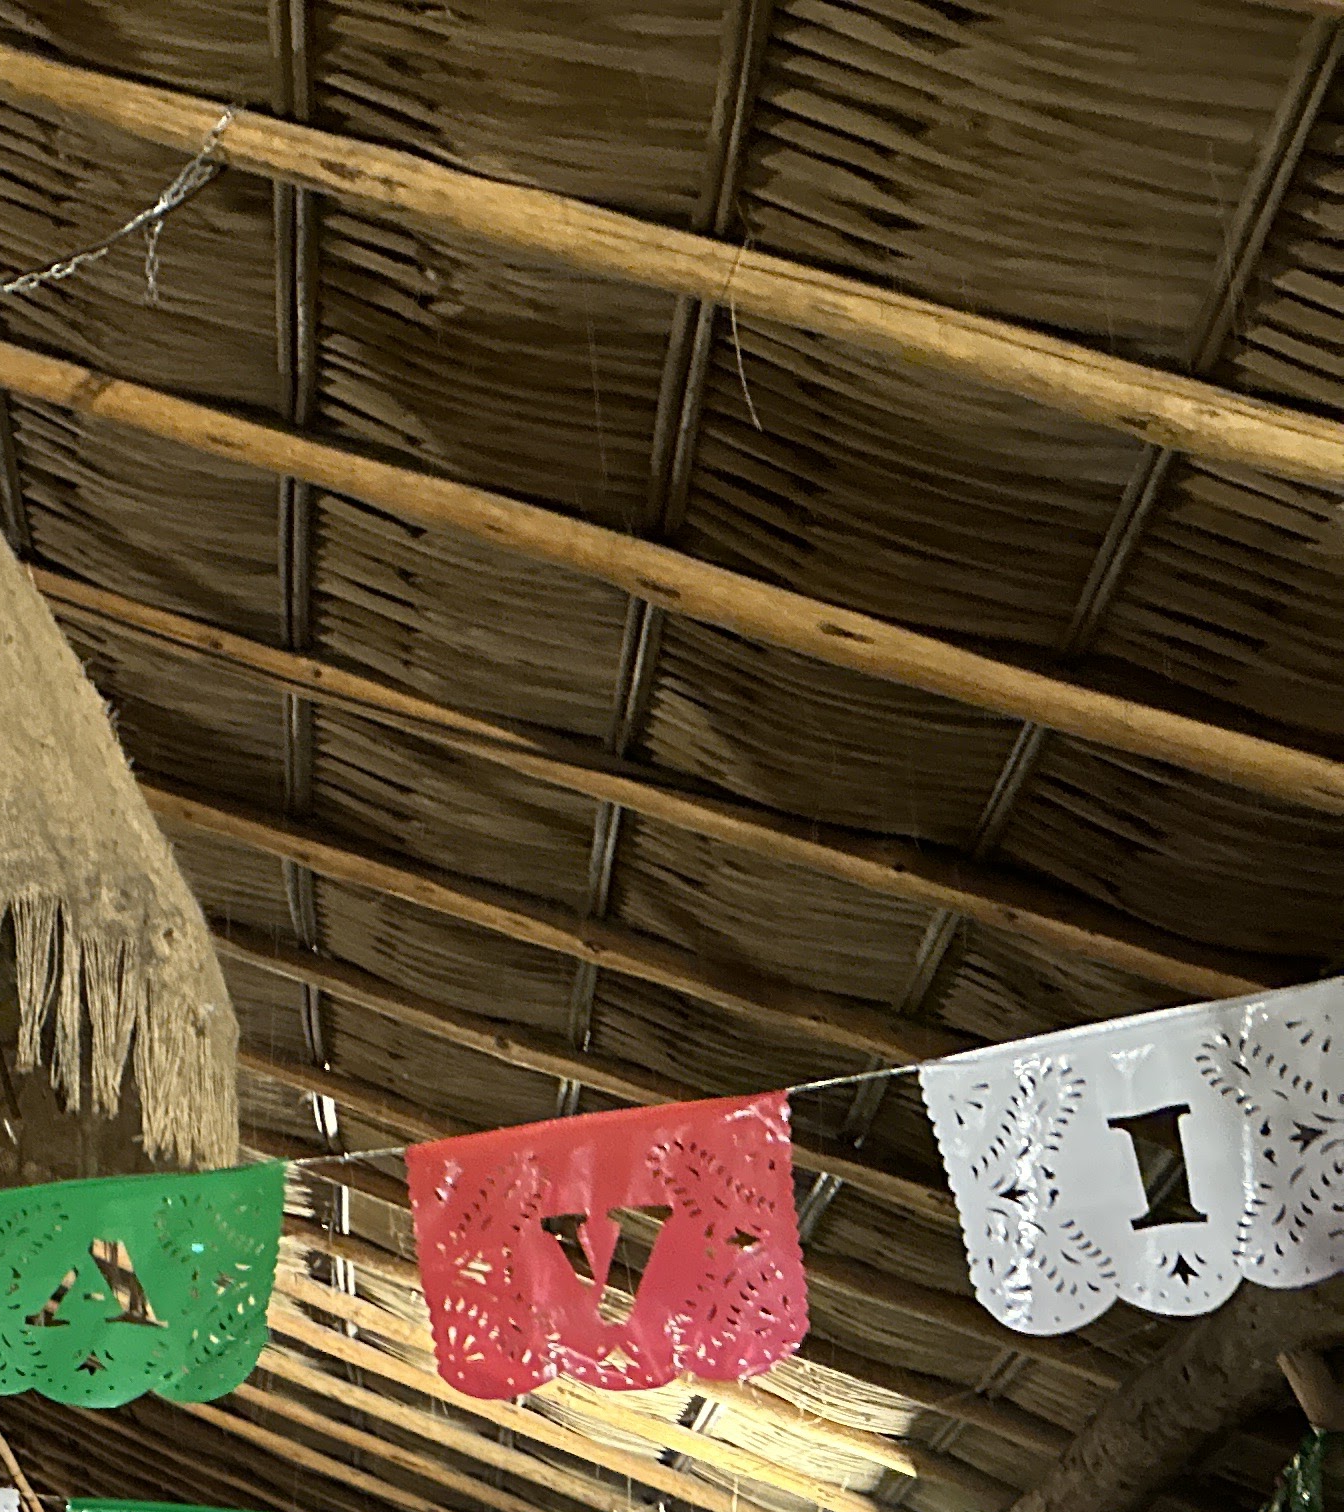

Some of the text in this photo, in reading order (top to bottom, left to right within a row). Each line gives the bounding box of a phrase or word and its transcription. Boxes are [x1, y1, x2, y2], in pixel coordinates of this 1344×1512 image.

[1106, 1103, 1209, 1231] I
[24, 1237, 169, 1328] A
[539, 1203, 677, 1327] V
